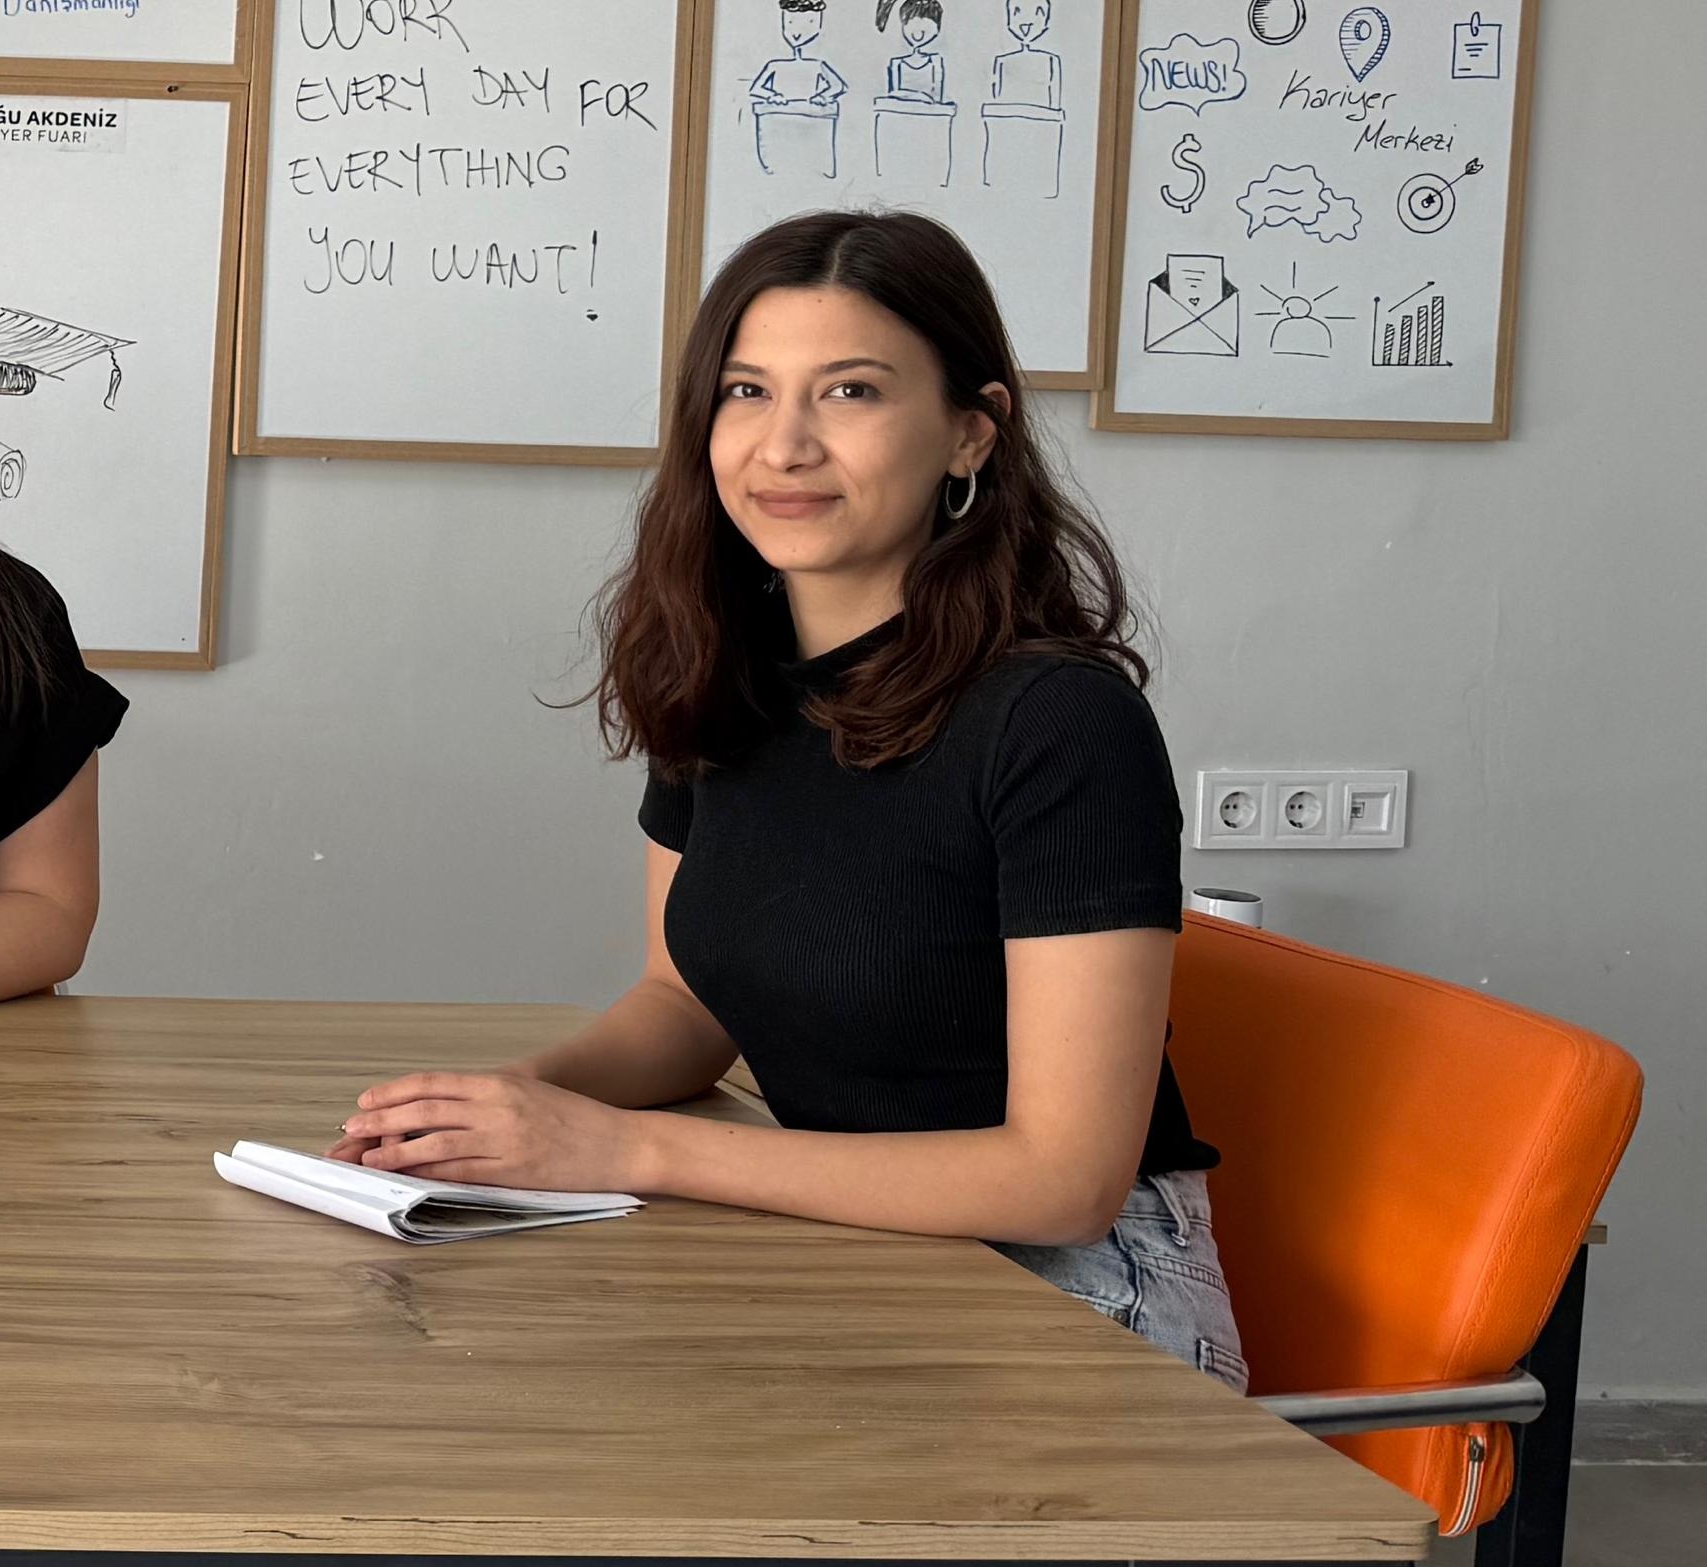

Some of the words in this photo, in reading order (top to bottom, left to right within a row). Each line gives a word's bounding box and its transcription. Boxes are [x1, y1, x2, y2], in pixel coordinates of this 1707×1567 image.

[295, 66, 431, 123] EVERY
[471, 64, 551, 114] DAY
[578, 79, 658, 132] FOR
[1150, 60, 1229, 94] NEWS!
[1278, 66, 1398, 122] Kariyer
[1353, 120, 1458, 153] Merkezi
[287, 142, 570, 198] EVERYTHING
[303, 226, 395, 295] YOU
